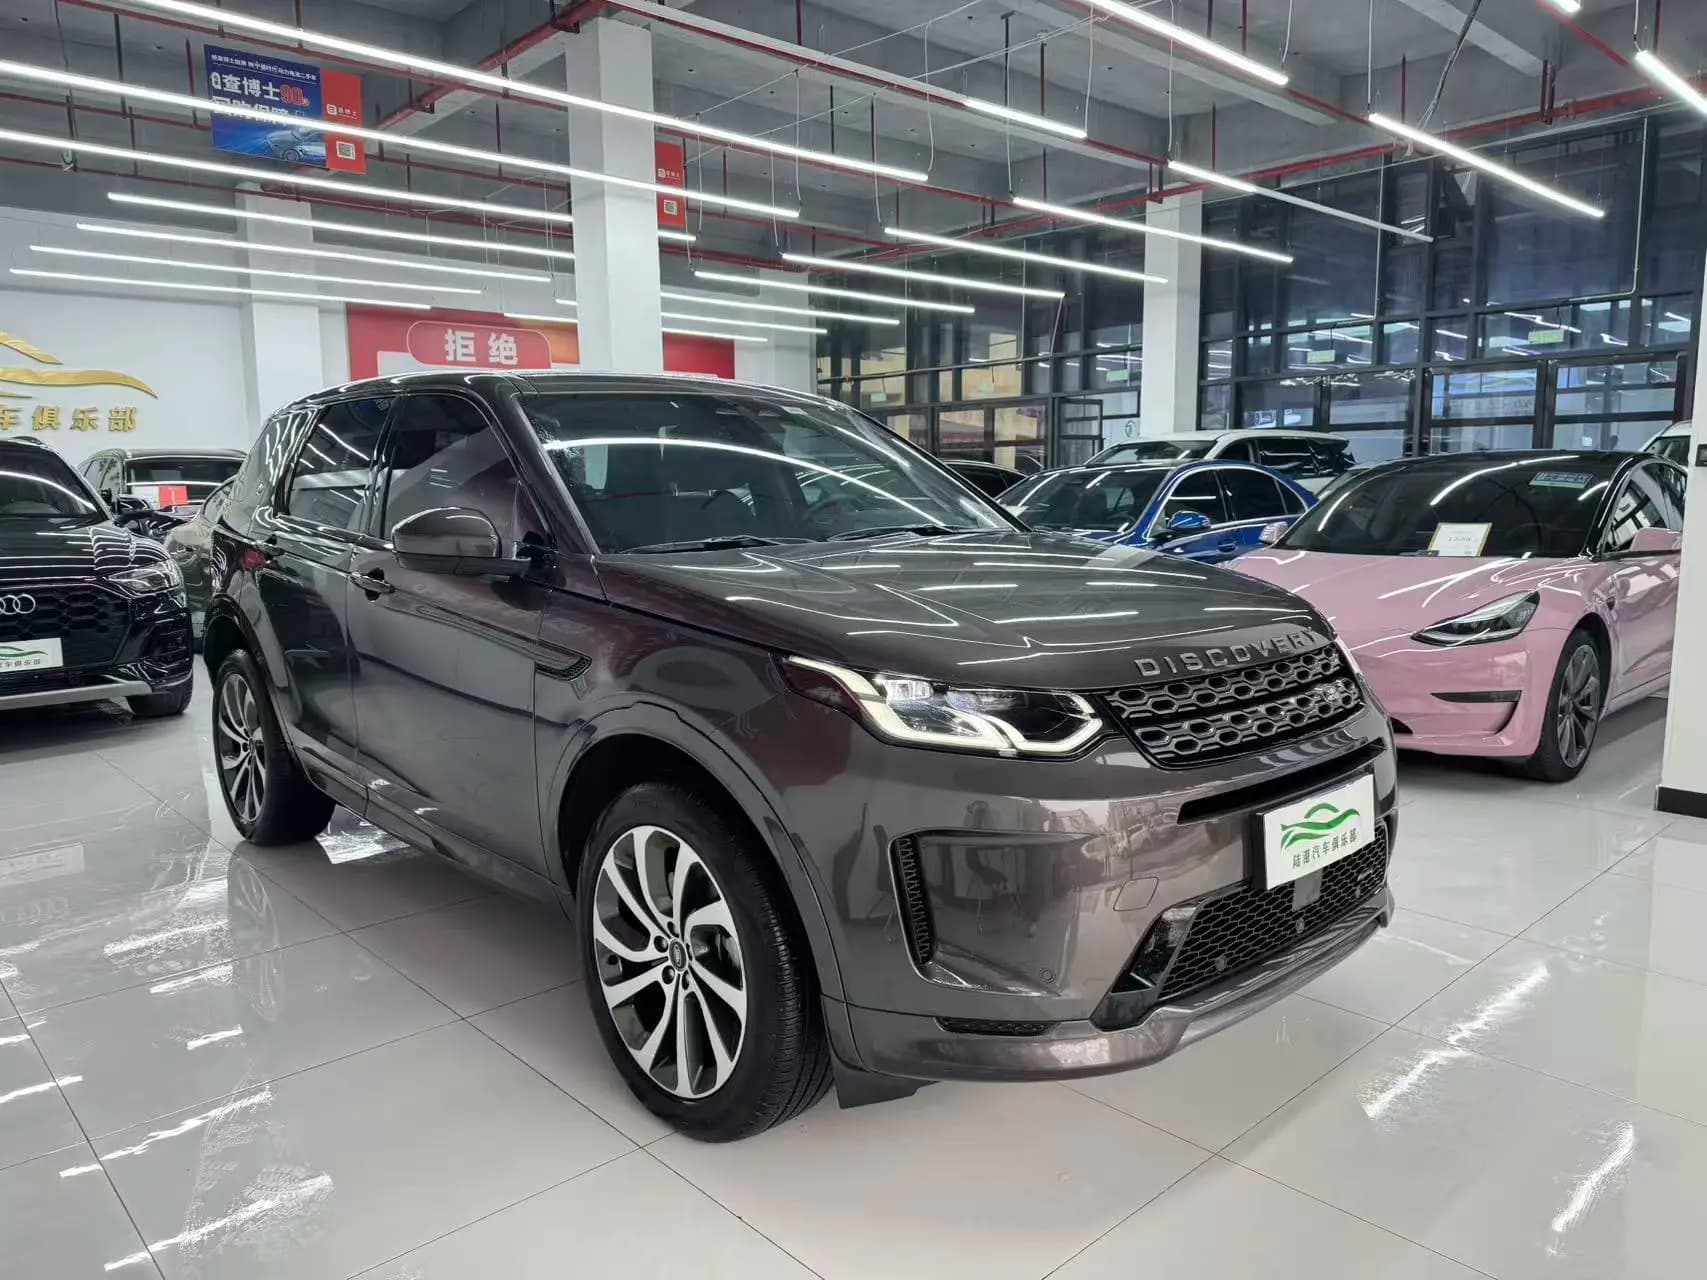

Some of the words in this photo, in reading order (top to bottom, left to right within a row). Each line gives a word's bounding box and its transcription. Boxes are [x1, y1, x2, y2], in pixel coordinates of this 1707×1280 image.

[444, 328, 519, 366] 拒绝
[0, 405, 137, 431] 车俱乐部
[1133, 627, 1317, 677] DISCOVERY
